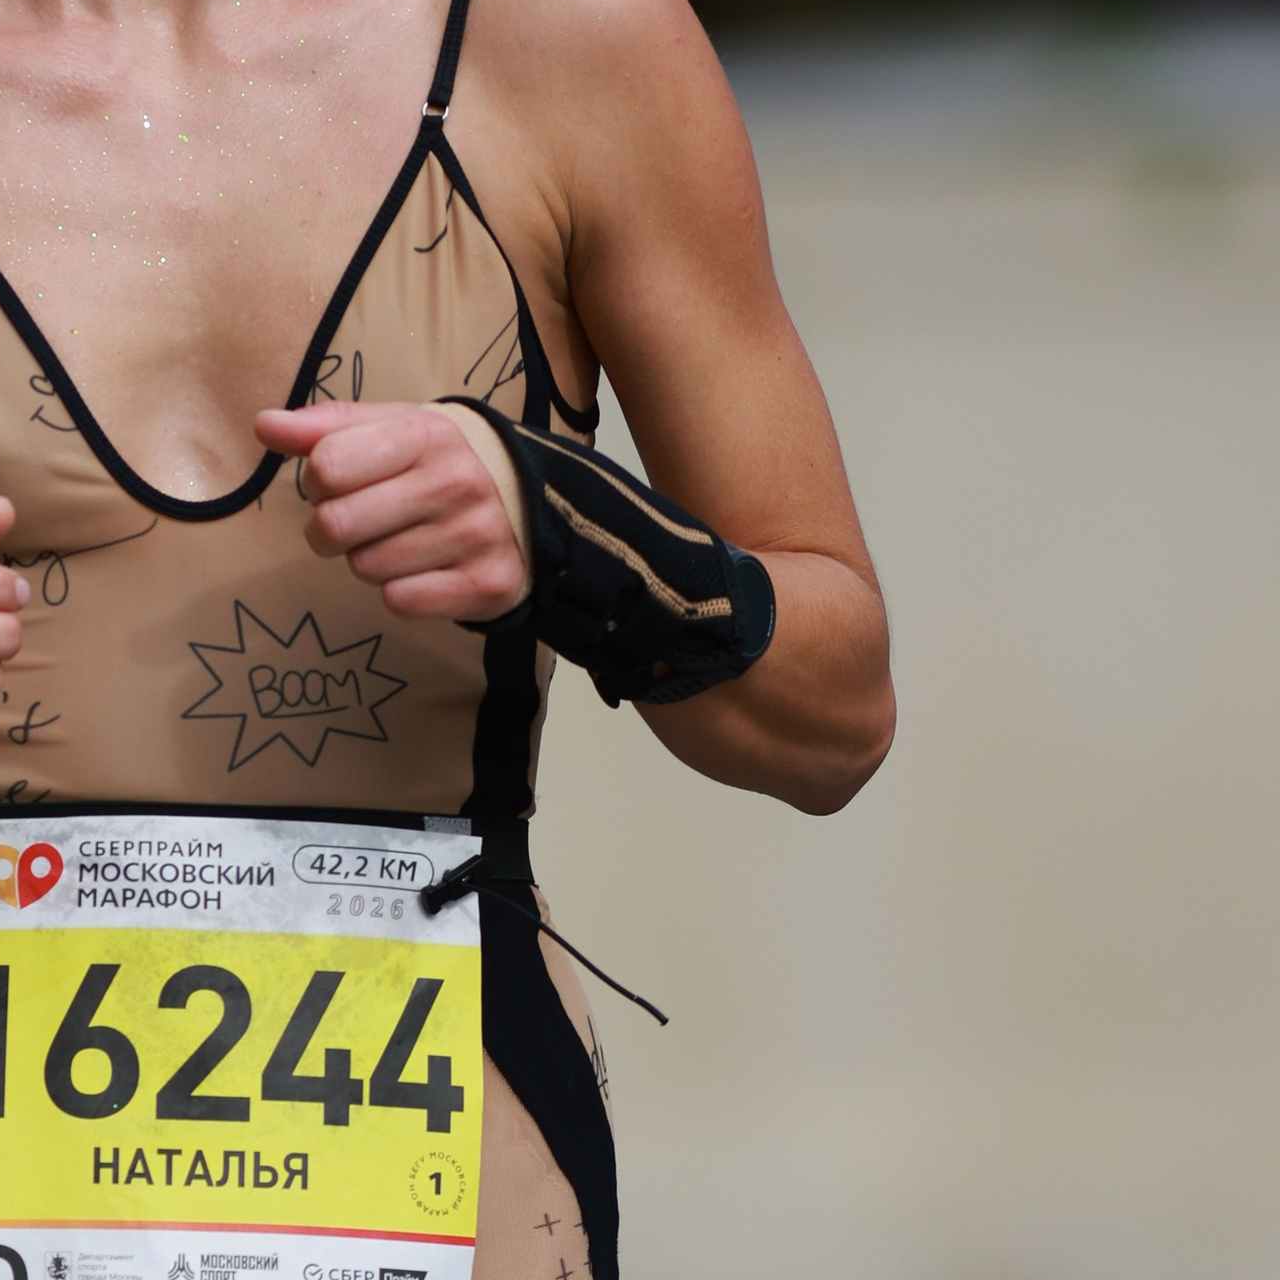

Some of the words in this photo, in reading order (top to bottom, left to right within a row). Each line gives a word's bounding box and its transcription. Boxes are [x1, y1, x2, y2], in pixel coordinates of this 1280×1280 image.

[248, 664, 363, 718] BOOM
[78, 838, 223, 859] СБЕРПРАЙМ
[77, 862, 276, 887] МОСКОВСКИЙ
[309, 853, 370, 880] 42,2
[76, 888, 222, 911] МАРАФОН
[326, 893, 404, 920] 2026
[92, 1146, 310, 1191] НАТАЛЬЯ
[428, 1171, 442, 1196] 1
[200, 1253, 279, 1271] МОСКОВСКИЙ
